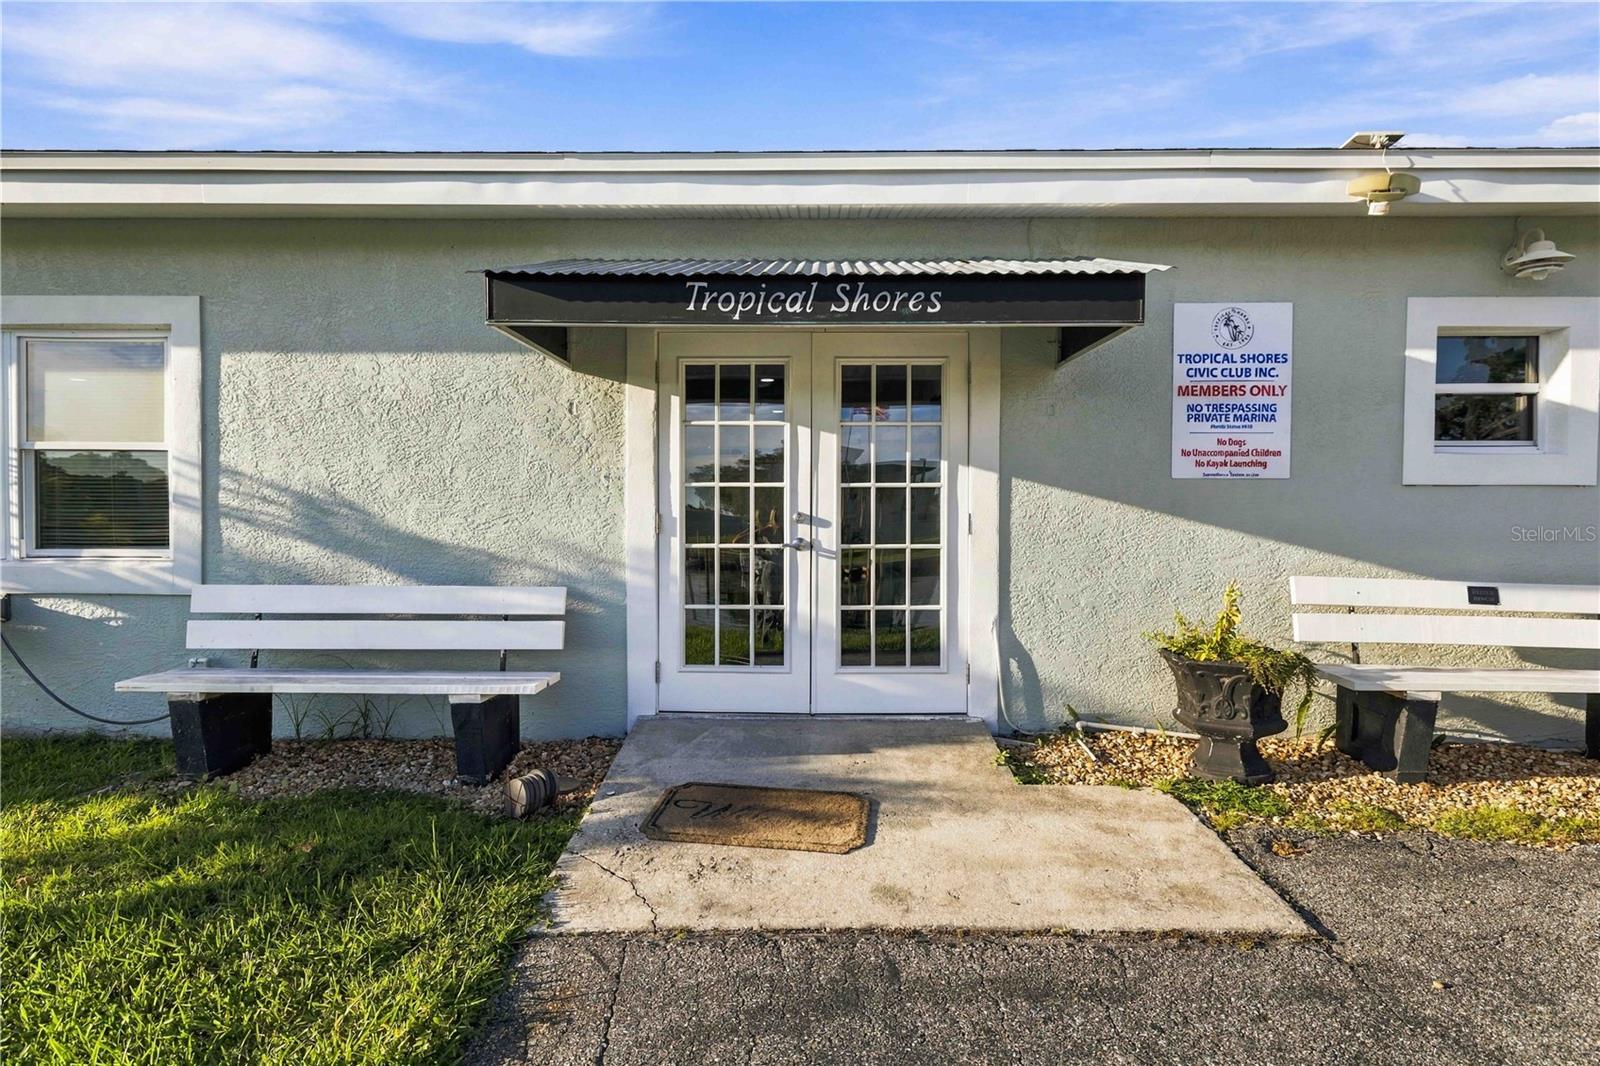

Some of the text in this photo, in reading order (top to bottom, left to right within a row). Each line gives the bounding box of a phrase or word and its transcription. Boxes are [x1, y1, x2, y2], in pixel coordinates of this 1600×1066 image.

[685, 281, 942, 320] Tropical Shores
[1177, 353, 1288, 364] TROPICAL SHORES
[1186, 367, 1279, 378] CIVIC CLUB INC.
[1177, 385, 1288, 397] MEMBERS ONLY
[1186, 403, 1277, 413] NO TRESPASSING
[1187, 413, 1277, 423] PRIVATE MARINA
[1217, 437, 1247, 448] No Dogs
[1181, 448, 1282, 458] No Unaccompanied Children
[1195, 459, 1267, 470] No Kayak Launching
